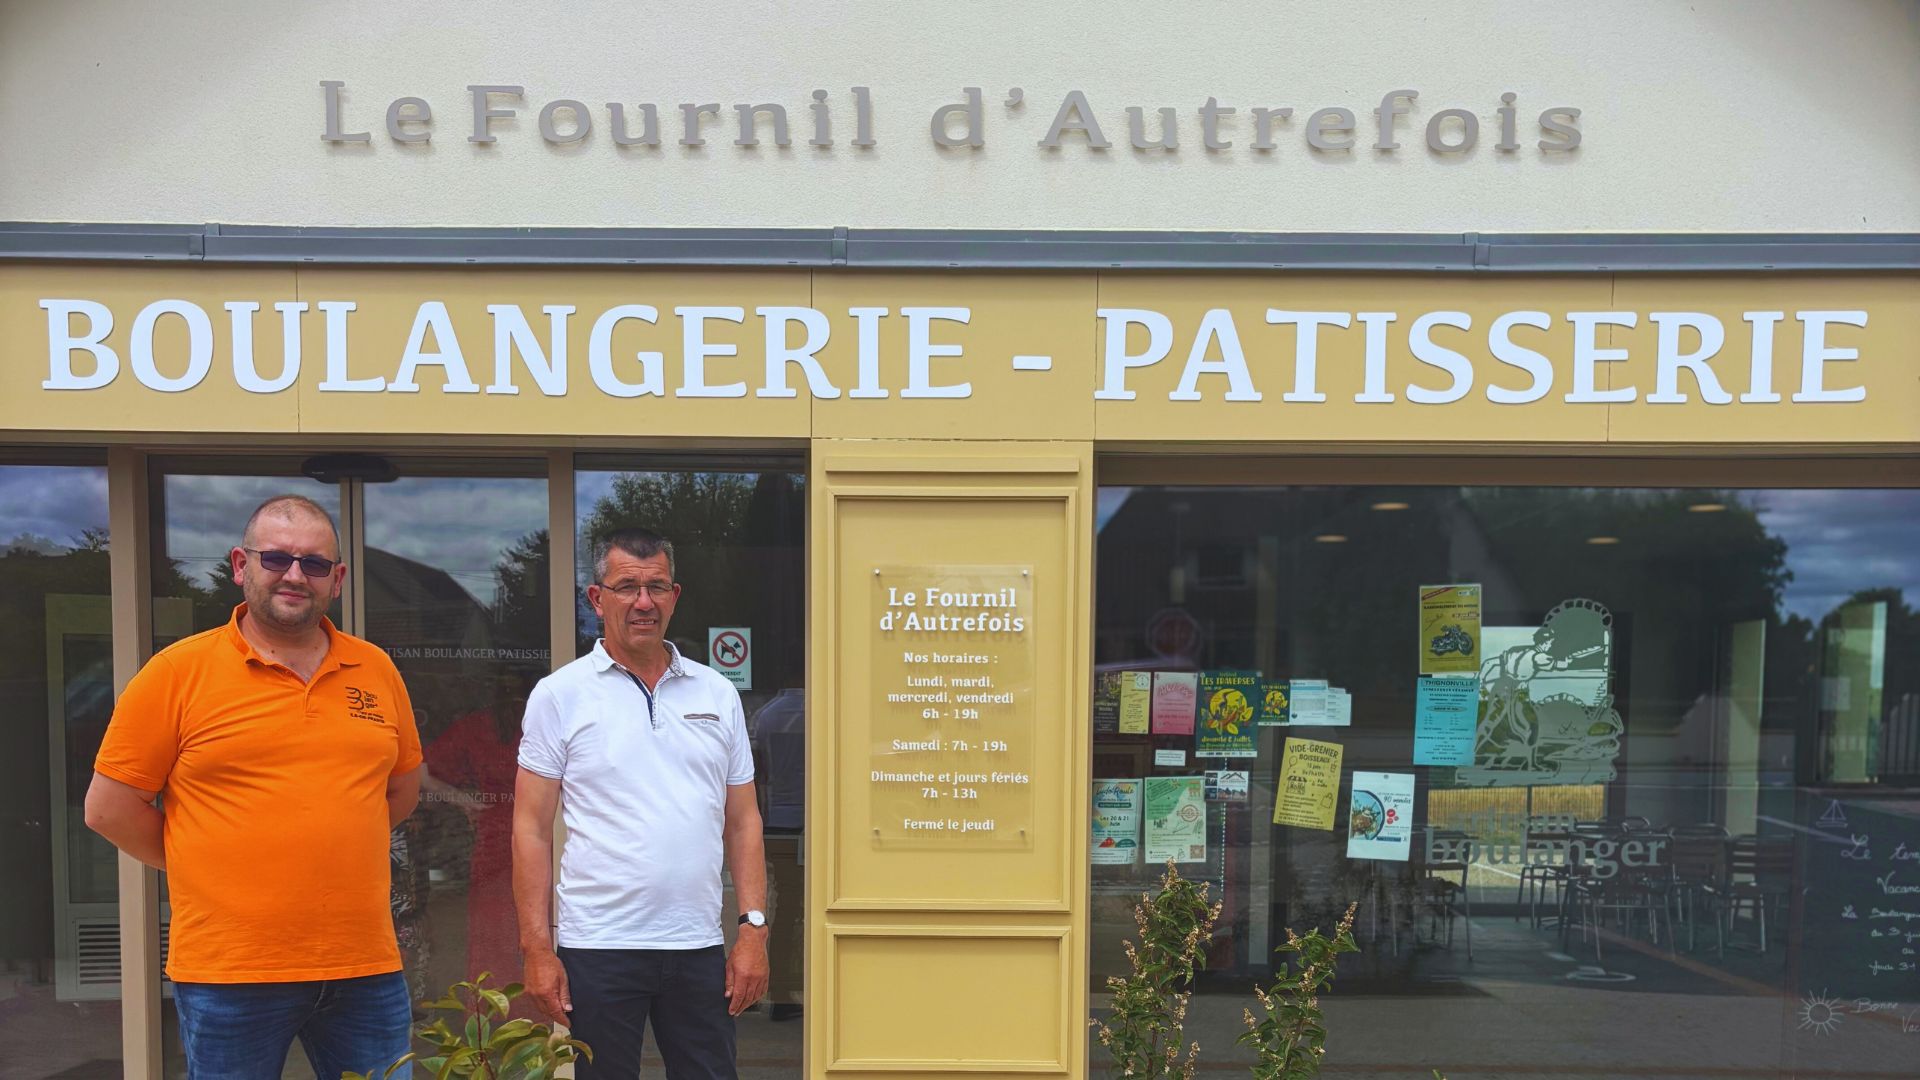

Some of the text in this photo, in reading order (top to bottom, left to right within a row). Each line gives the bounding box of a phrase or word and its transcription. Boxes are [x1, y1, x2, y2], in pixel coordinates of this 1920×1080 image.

[319, 80, 1582, 155] Le Fournil d'Autrefois
[39, 298, 1868, 404] BOULANGERIE - PATISSERIE
[888, 587, 1017, 608] Le Fournil
[879, 611, 1025, 632] d'Autrefois
[385, 648, 551, 660] TISAN BOULANGER PATISSIE
[903, 652, 929, 663] Nos
[932, 652, 989, 664] horaires
[907, 675, 994, 689] Lundi, mardi,
[887, 691, 1014, 705] mercredi, vendredi
[922, 708, 939, 719] 6h
[953, 708, 979, 719] 19h
[892, 738, 940, 751] Samedi
[951, 740, 968, 751] 7h
[983, 740, 1008, 752] 19h
[1289, 744, 1339, 759] VIDE-GRENIER
[871, 770, 1029, 785] Dimanche et jours fériés
[426, 792, 497, 803] BOULANGER
[921, 787, 938, 798] 7h
[953, 787, 978, 799] 13h
[903, 818, 995, 833] Fermé le jeudi
[1423, 827, 1667, 879] boulanger
